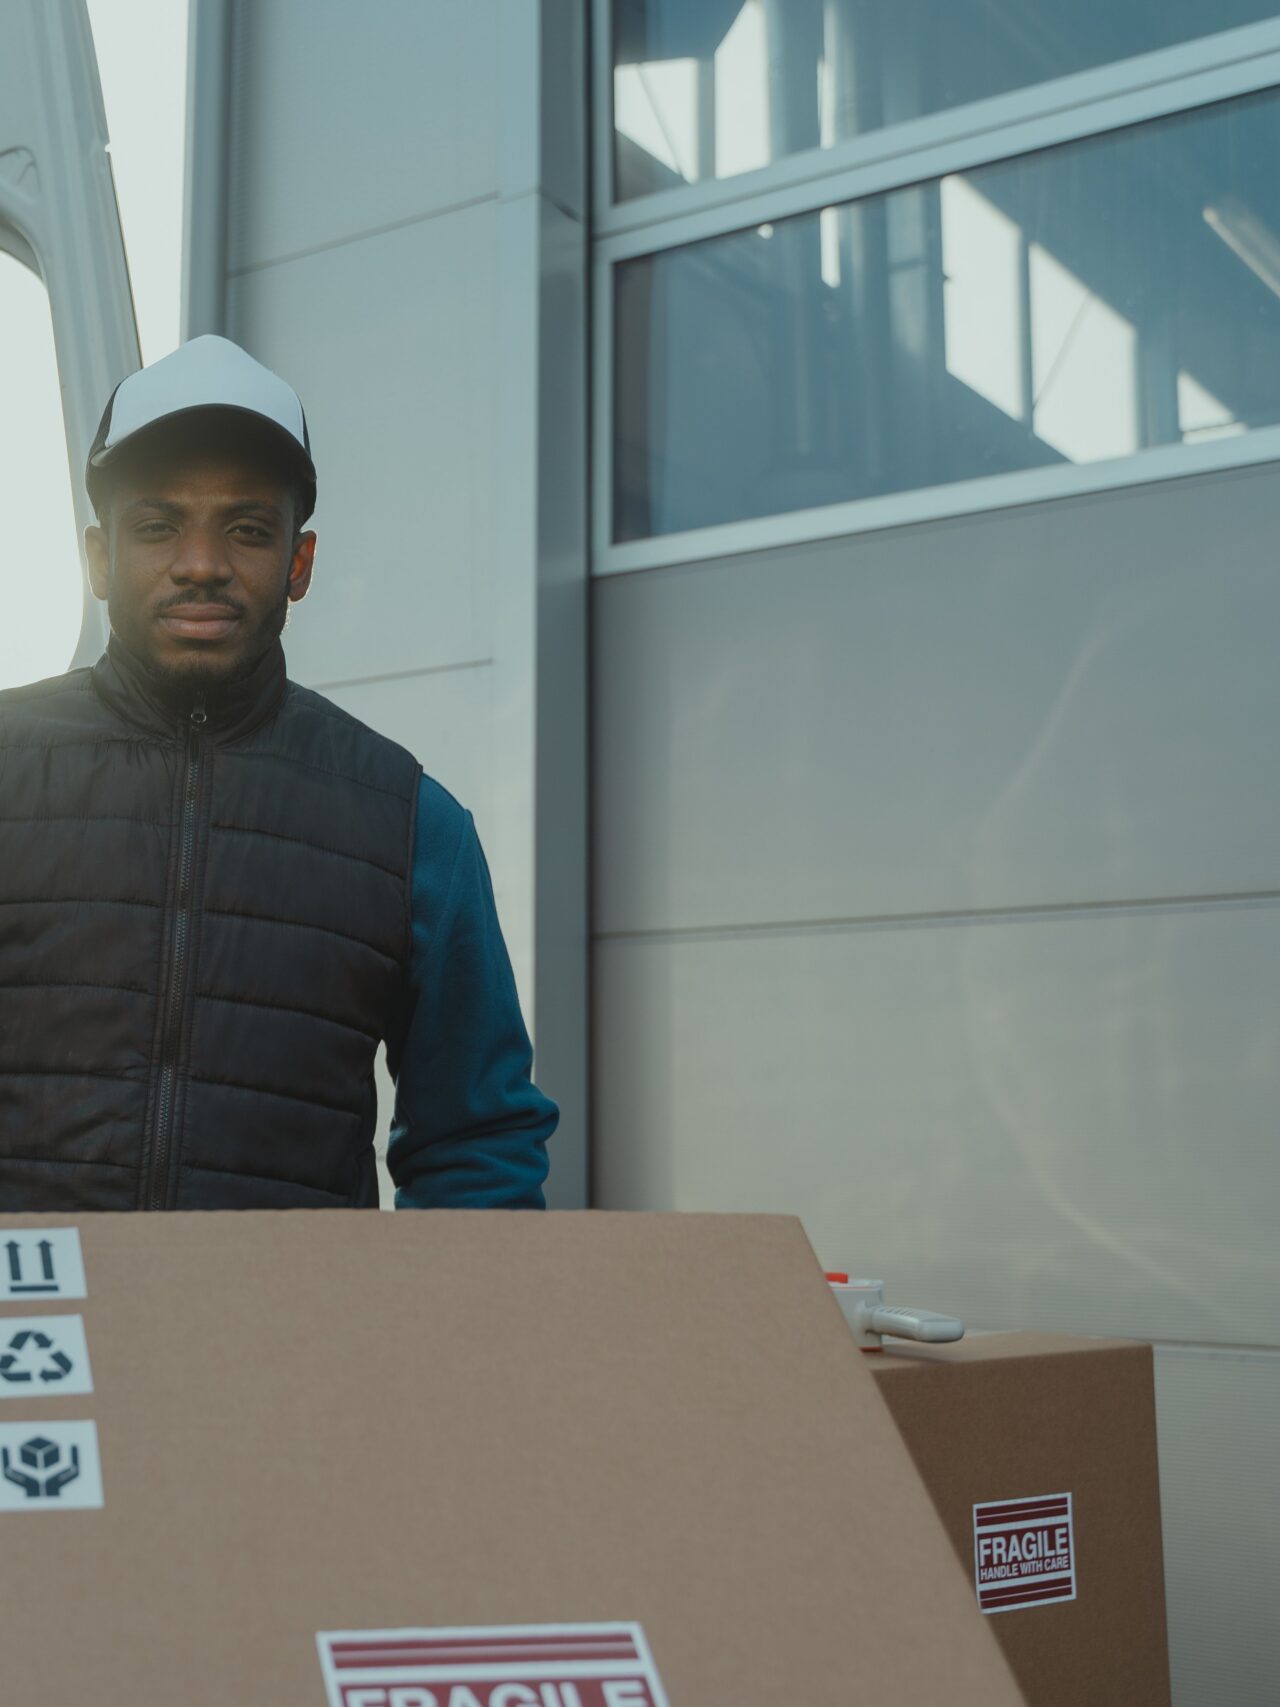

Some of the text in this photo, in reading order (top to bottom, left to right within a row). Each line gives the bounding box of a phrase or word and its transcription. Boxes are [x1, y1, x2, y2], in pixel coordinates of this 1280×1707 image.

[979, 1528, 1068, 1566] FRAGILE
[980, 1556, 1069, 1580] HANDLE WITH CARE
